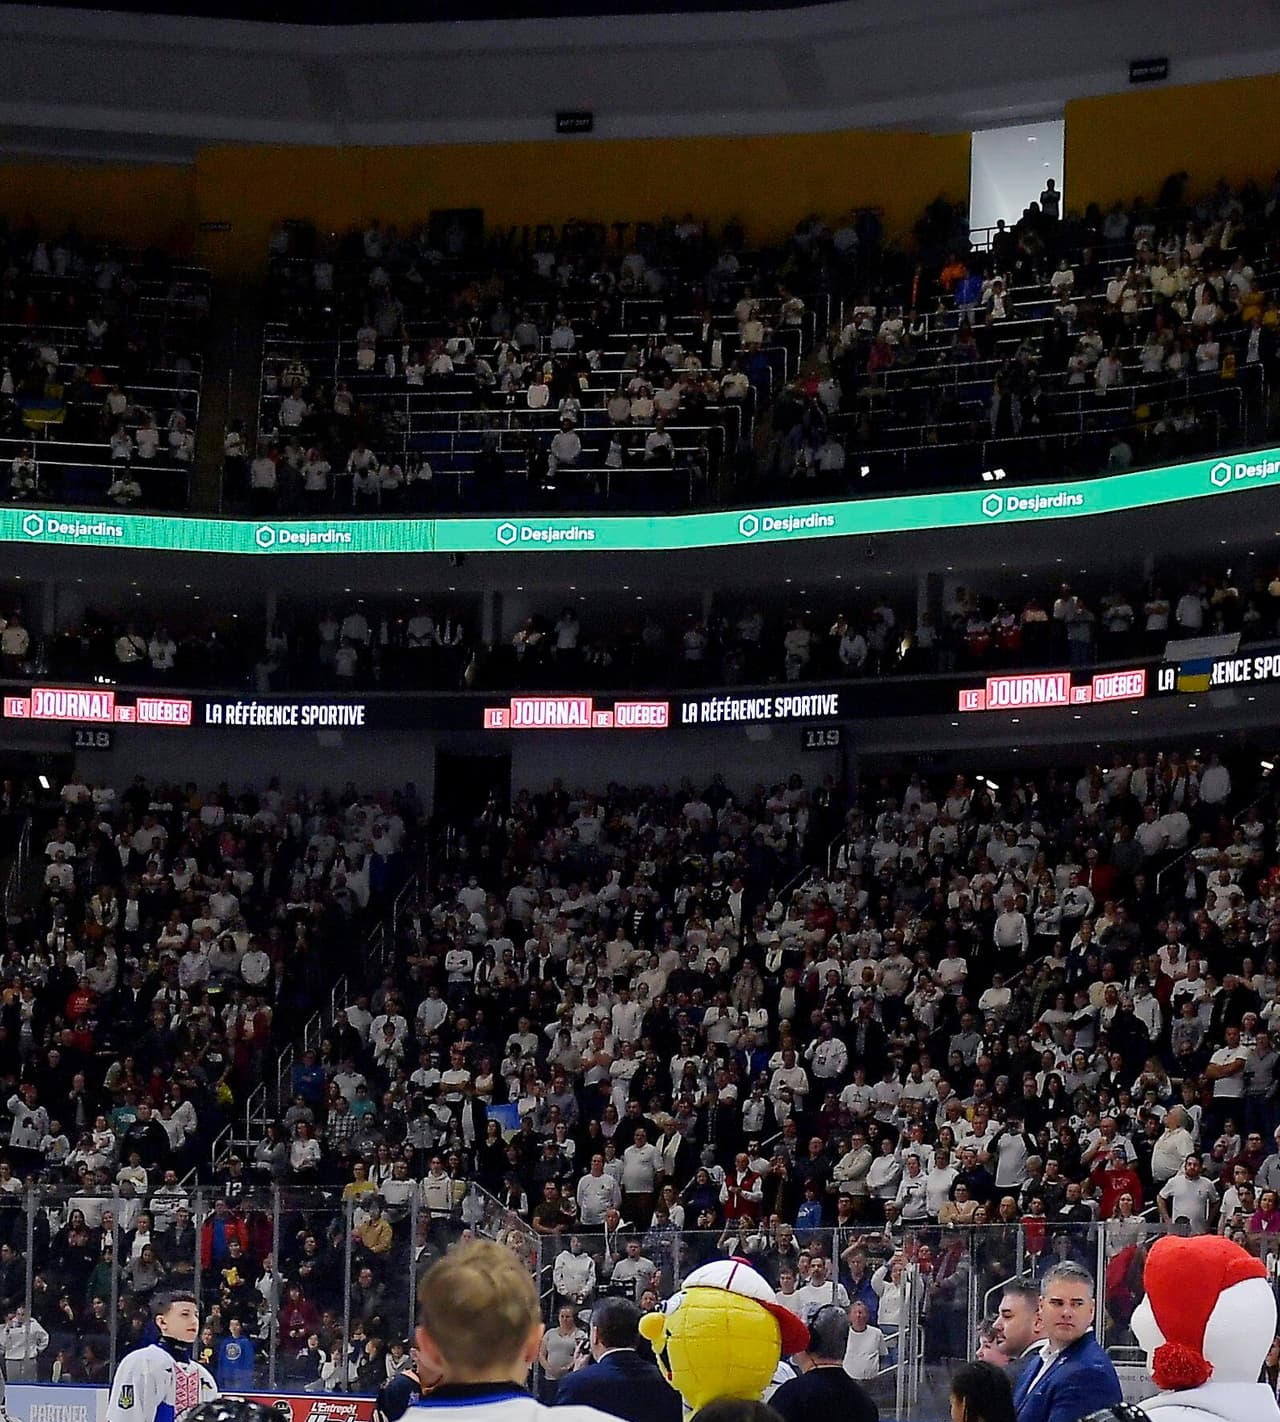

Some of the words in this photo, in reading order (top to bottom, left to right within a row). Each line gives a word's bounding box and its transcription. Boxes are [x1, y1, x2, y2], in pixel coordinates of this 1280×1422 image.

[1006, 491, 1083, 515] Desjardins
[47, 517, 123, 538] Desjardins
[762, 511, 834, 533] Desjardins
[279, 528, 352, 546] Desjardins
[520, 525, 595, 544] Desjardins
[966, 694, 978, 708] LE
[989, 677, 1066, 706] JOURNAL
[1076, 688, 1087, 701] DE
[1095, 673, 1142, 698] QUÉBEC
[1158, 668, 1174, 692] LA
[11, 701, 24, 715] LE
[35, 692, 111, 719] JOURNAL
[120, 708, 131, 720] DE
[140, 702, 188, 722] QUÉBEC
[205, 704, 222, 724] LA
[225, 701, 298, 726] RÉFÉRENCE
[301, 704, 365, 726] SPORTIVE
[491, 712, 503, 725] LE
[514, 701, 588, 726] JOURNAL
[597, 714, 608, 725] DE
[617, 704, 666, 725] QUÉBEC
[682, 703, 697, 724] LA
[701, 697, 772, 722] RÉFÉRENCE
[775, 694, 839, 718] SPORTIVE
[74, 732, 110, 748] 118
[806, 729, 840, 747] 119
